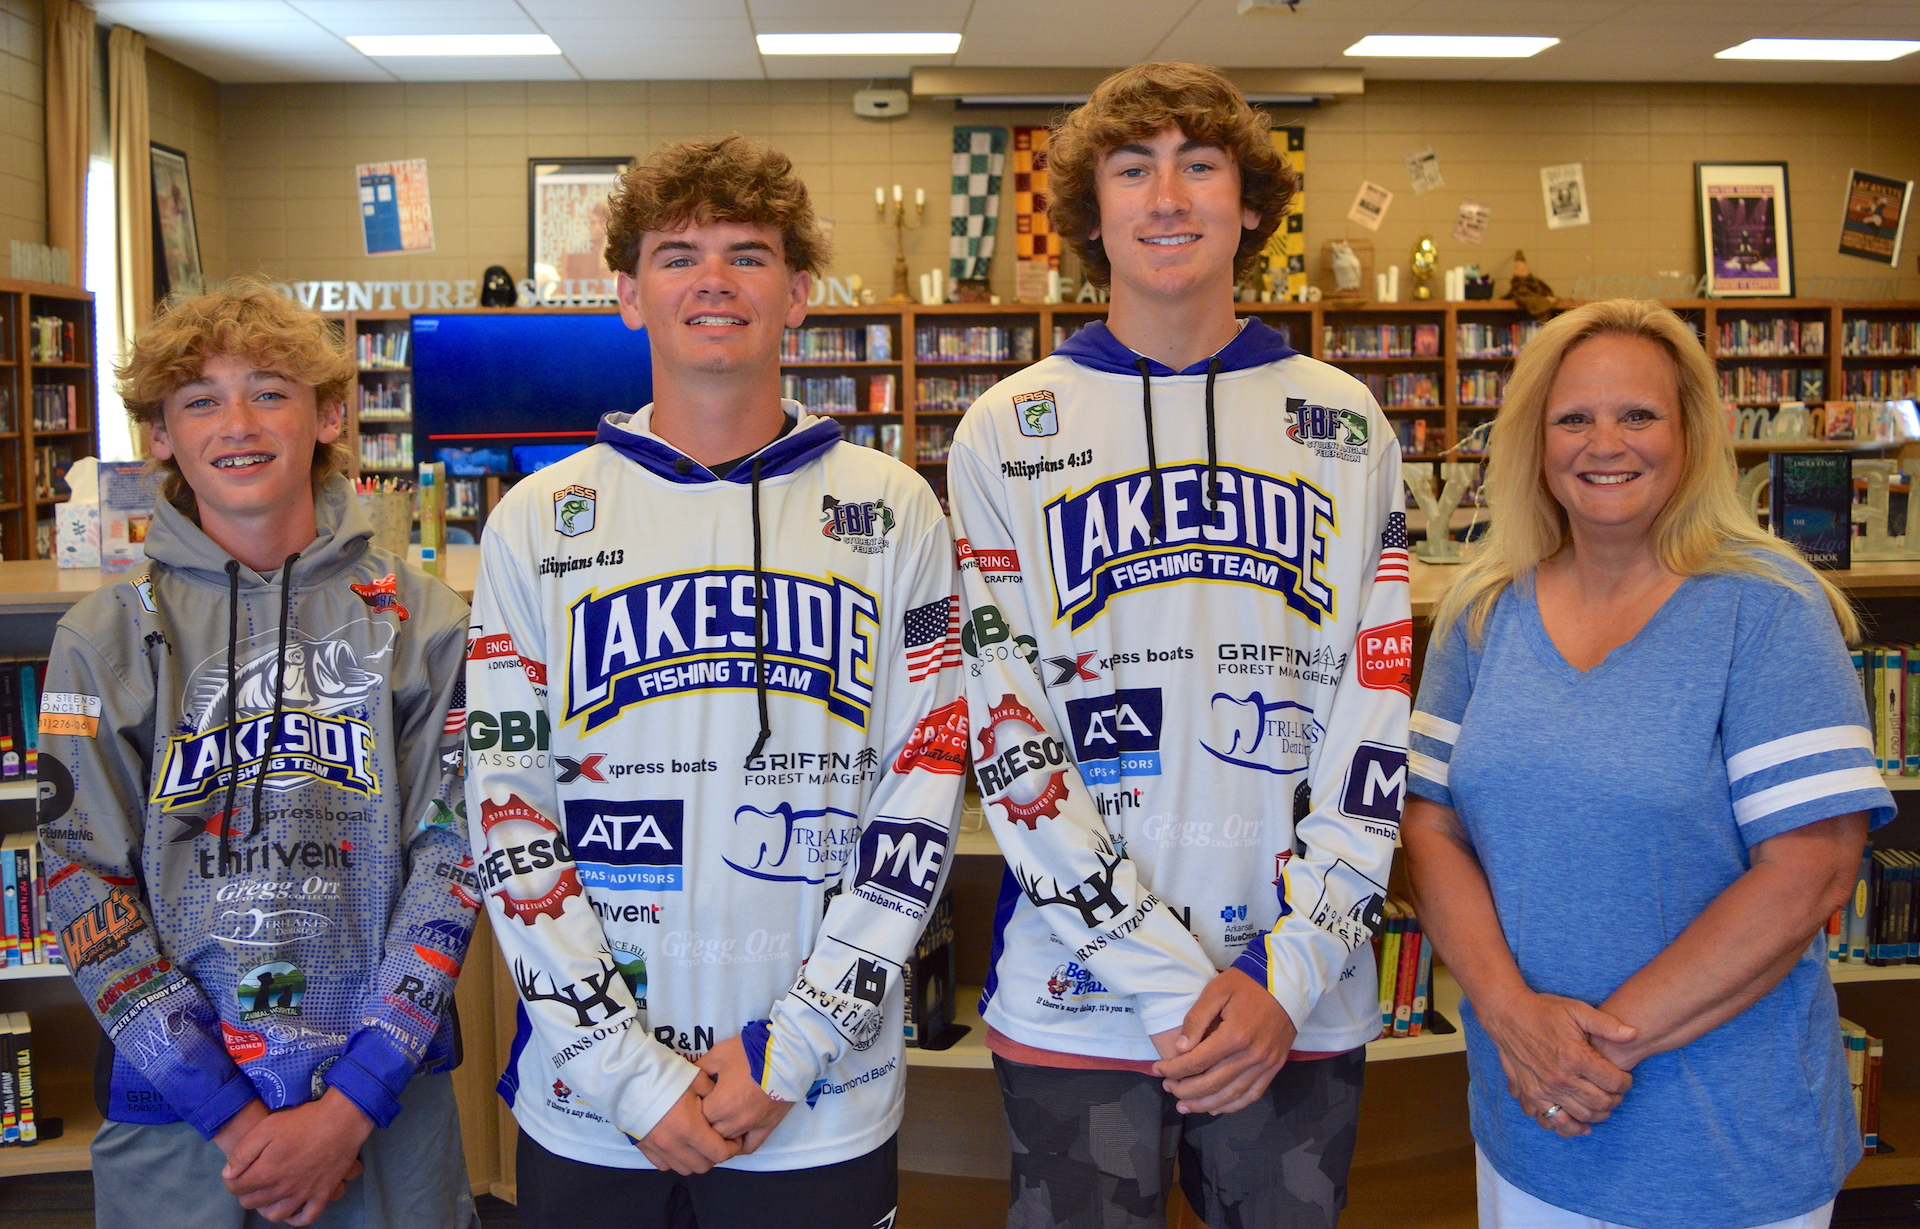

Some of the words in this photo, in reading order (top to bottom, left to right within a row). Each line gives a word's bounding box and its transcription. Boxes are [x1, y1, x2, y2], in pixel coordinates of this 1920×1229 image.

[1014, 391, 1053, 404] BASS
[1067, 449, 1093, 468] 4:13
[554, 487, 595, 501] BASS
[1048, 469, 1332, 611] LAKESIDE
[596, 549, 625, 567] 4:13
[1111, 551, 1204, 590] FISHING
[1207, 553, 1280, 588] TEAM
[571, 575, 875, 713] LAKESIDE
[1146, 645, 1194, 663] boats
[1217, 664, 1275, 675] FOREST
[638, 661, 730, 697] FISHING
[737, 661, 812, 693] TEAM
[161, 712, 373, 796] LAKESIDE
[291, 757, 330, 778] TEAM
[608, 763, 665, 779] xpress
[671, 758, 718, 773] boats
[744, 773, 804, 786] FOREST
[488, 808, 530, 822] SPRINGS,
[1009, 798, 1049, 816] ESTABLISHED
[39, 828, 94, 842] PLUMBING
[577, 813, 674, 852] ATA
[1142, 813, 1214, 846] Gregg
[1222, 812, 1263, 841] Orr
[1211, 838, 1261, 849] COLLECTION
[198, 835, 356, 880] thrivent
[216, 880, 295, 903] Gregg
[301, 875, 342, 895] Orr
[288, 892, 341, 901] COLLECTION
[62, 888, 139, 970] HILL'S
[1224, 923, 1254, 933] Arkansas
[406, 923, 461, 956] STEAM
[660, 931, 736, 965] Gregg
[743, 928, 791, 955] Orr
[732, 950, 790, 964] COLLECTION
[96, 957, 172, 1014] GARNER'S
[129, 998, 148, 1018] AUTO
[147, 986, 170, 1004] BODY
[1042, 997, 1065, 1011] there's
[1065, 1004, 1079, 1014] any
[1098, 1003, 1110, 1012] it's
[1110, 1004, 1124, 1014] you
[243, 1010, 271, 1021] ANIMAL
[229, 1042, 263, 1051] CORNER
[654, 1024, 712, 1053] R&N
[16, 1048, 31, 1066] OLA
[269, 1045, 297, 1056] Gary
[298, 1041, 317, 1051] Cox
[551, 1036, 593, 1069] HORNS
[17, 1066, 35, 1098] QUINTA
[821, 1071, 869, 1095] Diamond
[870, 1058, 895, 1080] Bank
[20, 1097, 34, 1109] LA
[127, 1103, 164, 1112] FOREST
[551, 1101, 571, 1115] there's
[571, 1107, 584, 1119] any
